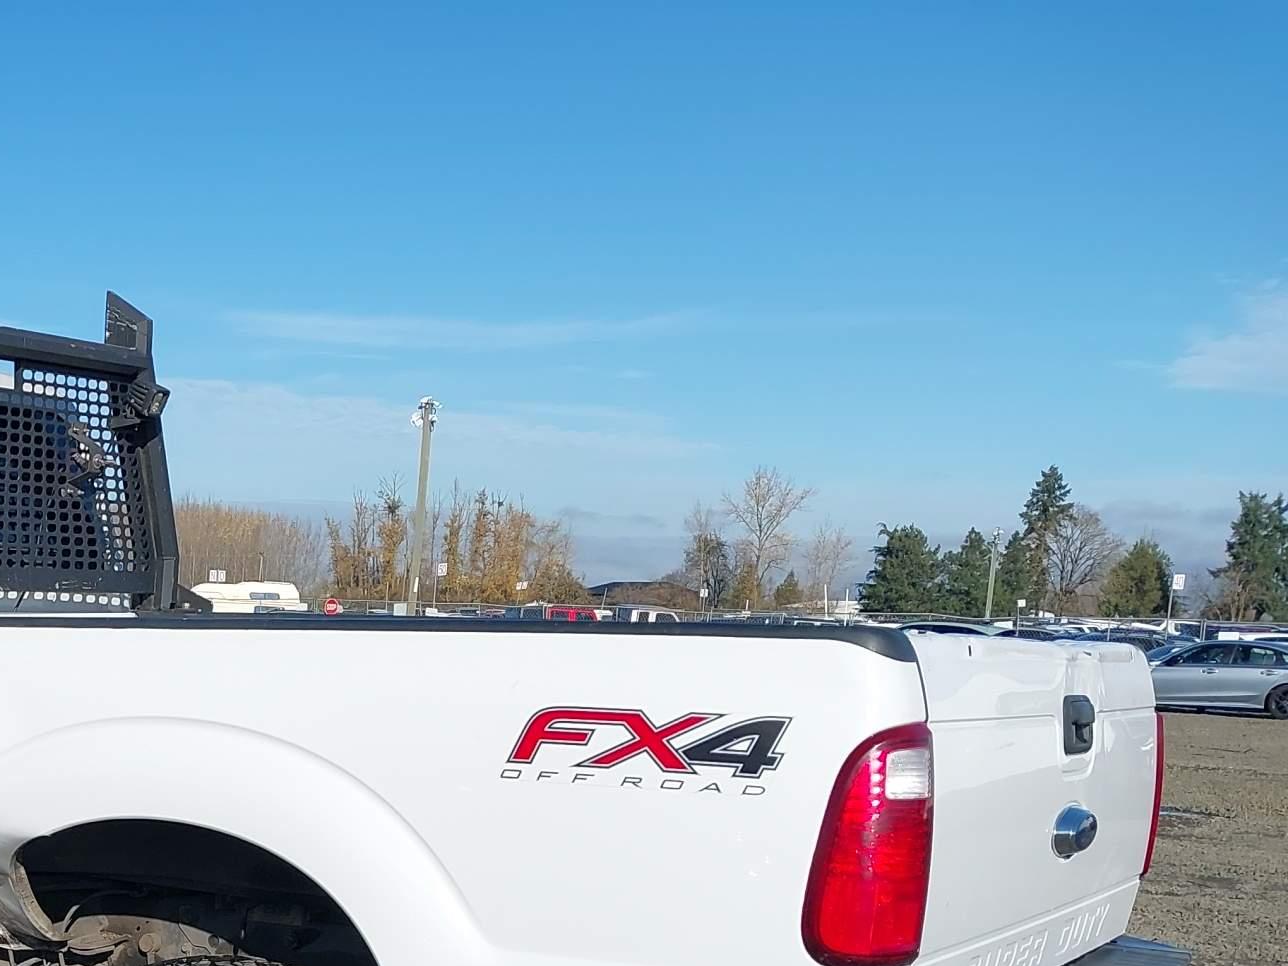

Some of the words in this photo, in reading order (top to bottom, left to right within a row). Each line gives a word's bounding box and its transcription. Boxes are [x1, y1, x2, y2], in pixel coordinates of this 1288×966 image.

[506, 706, 793, 779] FX4
[500, 768, 595, 784] OFF
[620, 776, 766, 796] ROAD
[1055, 903, 1111, 957] DUTY
